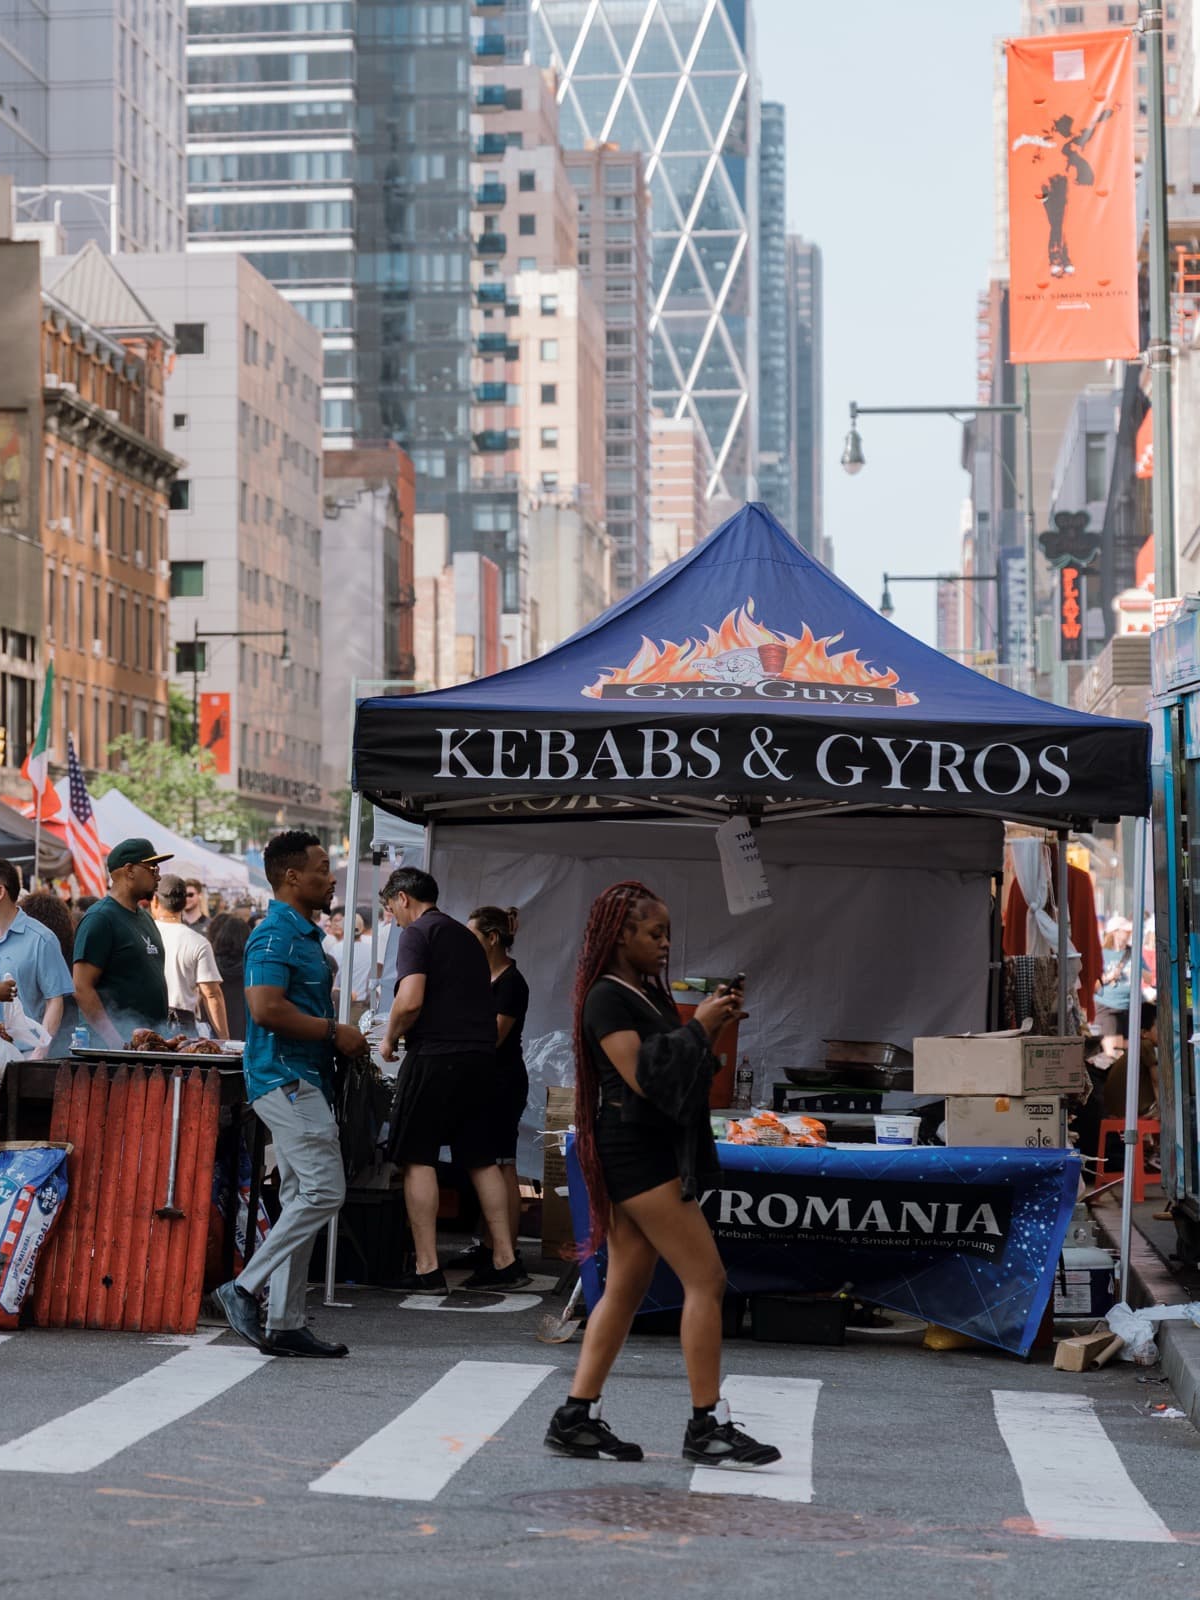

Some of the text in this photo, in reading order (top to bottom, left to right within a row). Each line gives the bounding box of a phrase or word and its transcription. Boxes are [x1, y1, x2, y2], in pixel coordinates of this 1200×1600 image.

[625, 679, 875, 706] Gyro Guys
[433, 725, 1072, 797] KEBABS & GYROS
[697, 1189, 1003, 1237] YROMANIA
[862, 1236, 910, 1247] Smoked
[913, 1238, 954, 1249] Turkey
[957, 1239, 996, 1253] Drums
